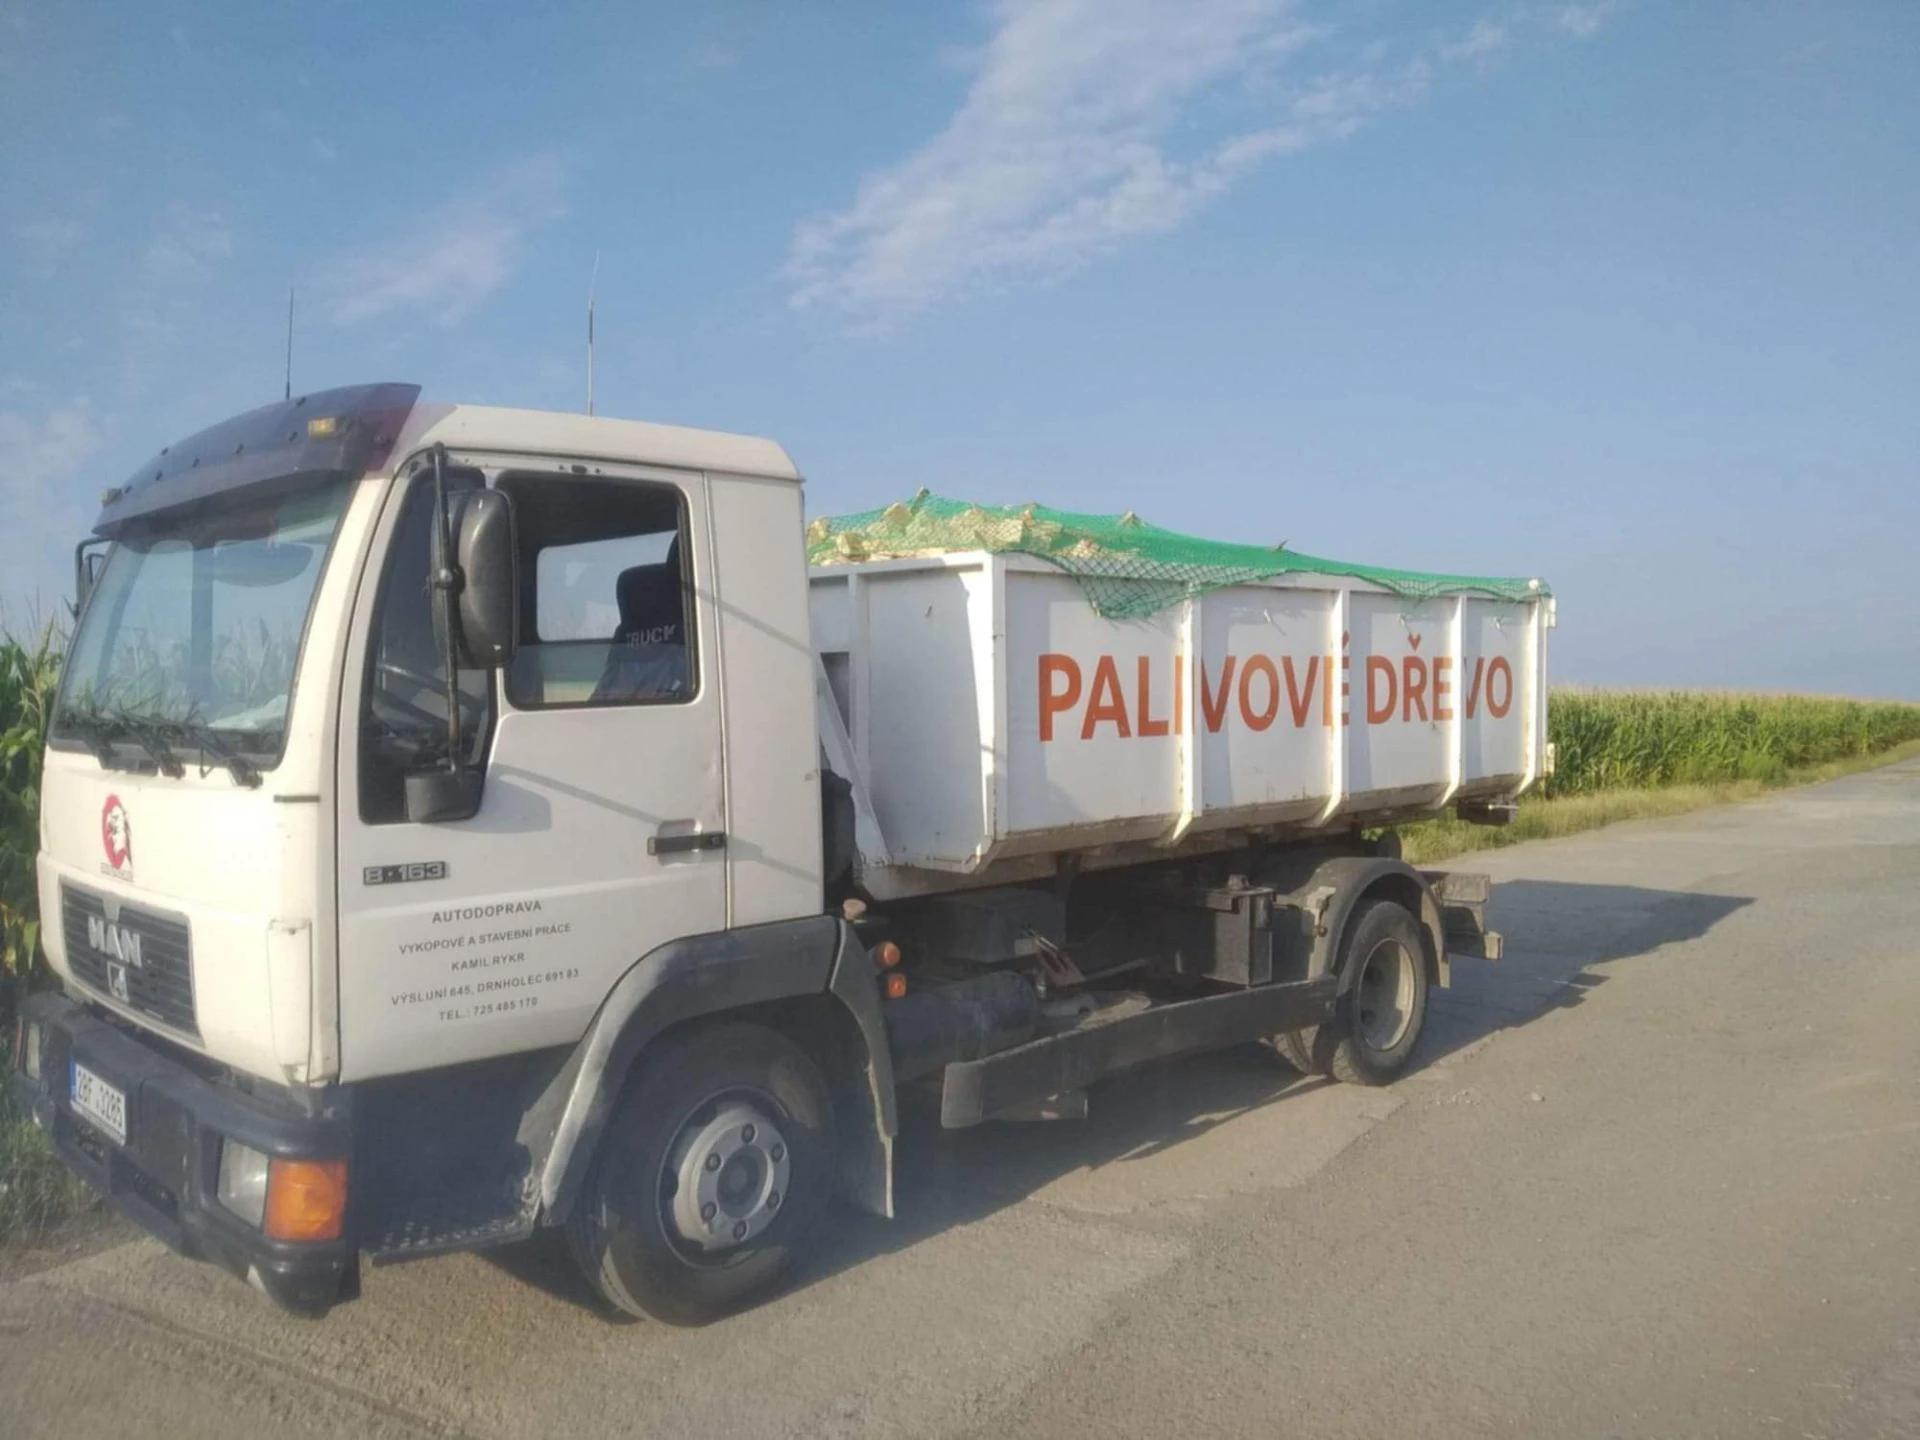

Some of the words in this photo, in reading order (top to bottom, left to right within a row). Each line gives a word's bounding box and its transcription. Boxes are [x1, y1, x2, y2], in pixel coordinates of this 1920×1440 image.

[625, 624, 676, 649] TRUCK
[1037, 630, 1350, 742] PALIVOVÉ
[1366, 634, 1513, 725] DŘEVO
[431, 899, 542, 924] AUTODOPRAVA
[88, 914, 142, 968] MAN
[468, 935, 477, 947] A
[450, 957, 491, 972] KAMIL
[476, 974, 543, 994] DRNHOLEC
[473, 1003, 494, 1017] 725
